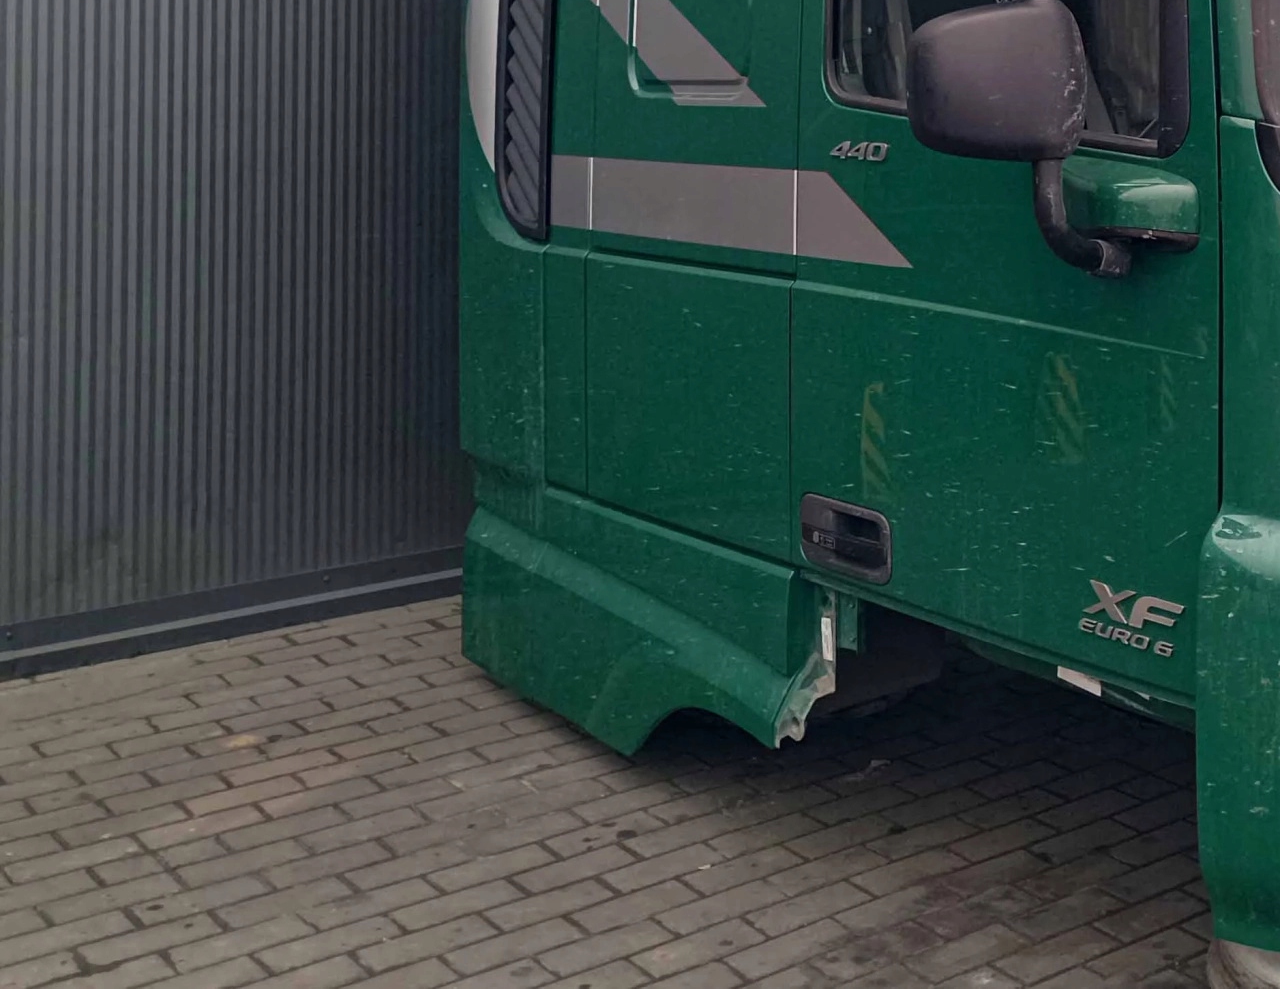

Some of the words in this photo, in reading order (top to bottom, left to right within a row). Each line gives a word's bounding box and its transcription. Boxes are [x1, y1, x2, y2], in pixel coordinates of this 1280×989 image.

[829, 140, 890, 162] 440
[1082, 579, 1185, 629] XF
[1078, 617, 1150, 650] EURO
[1153, 640, 1175, 658] 6
